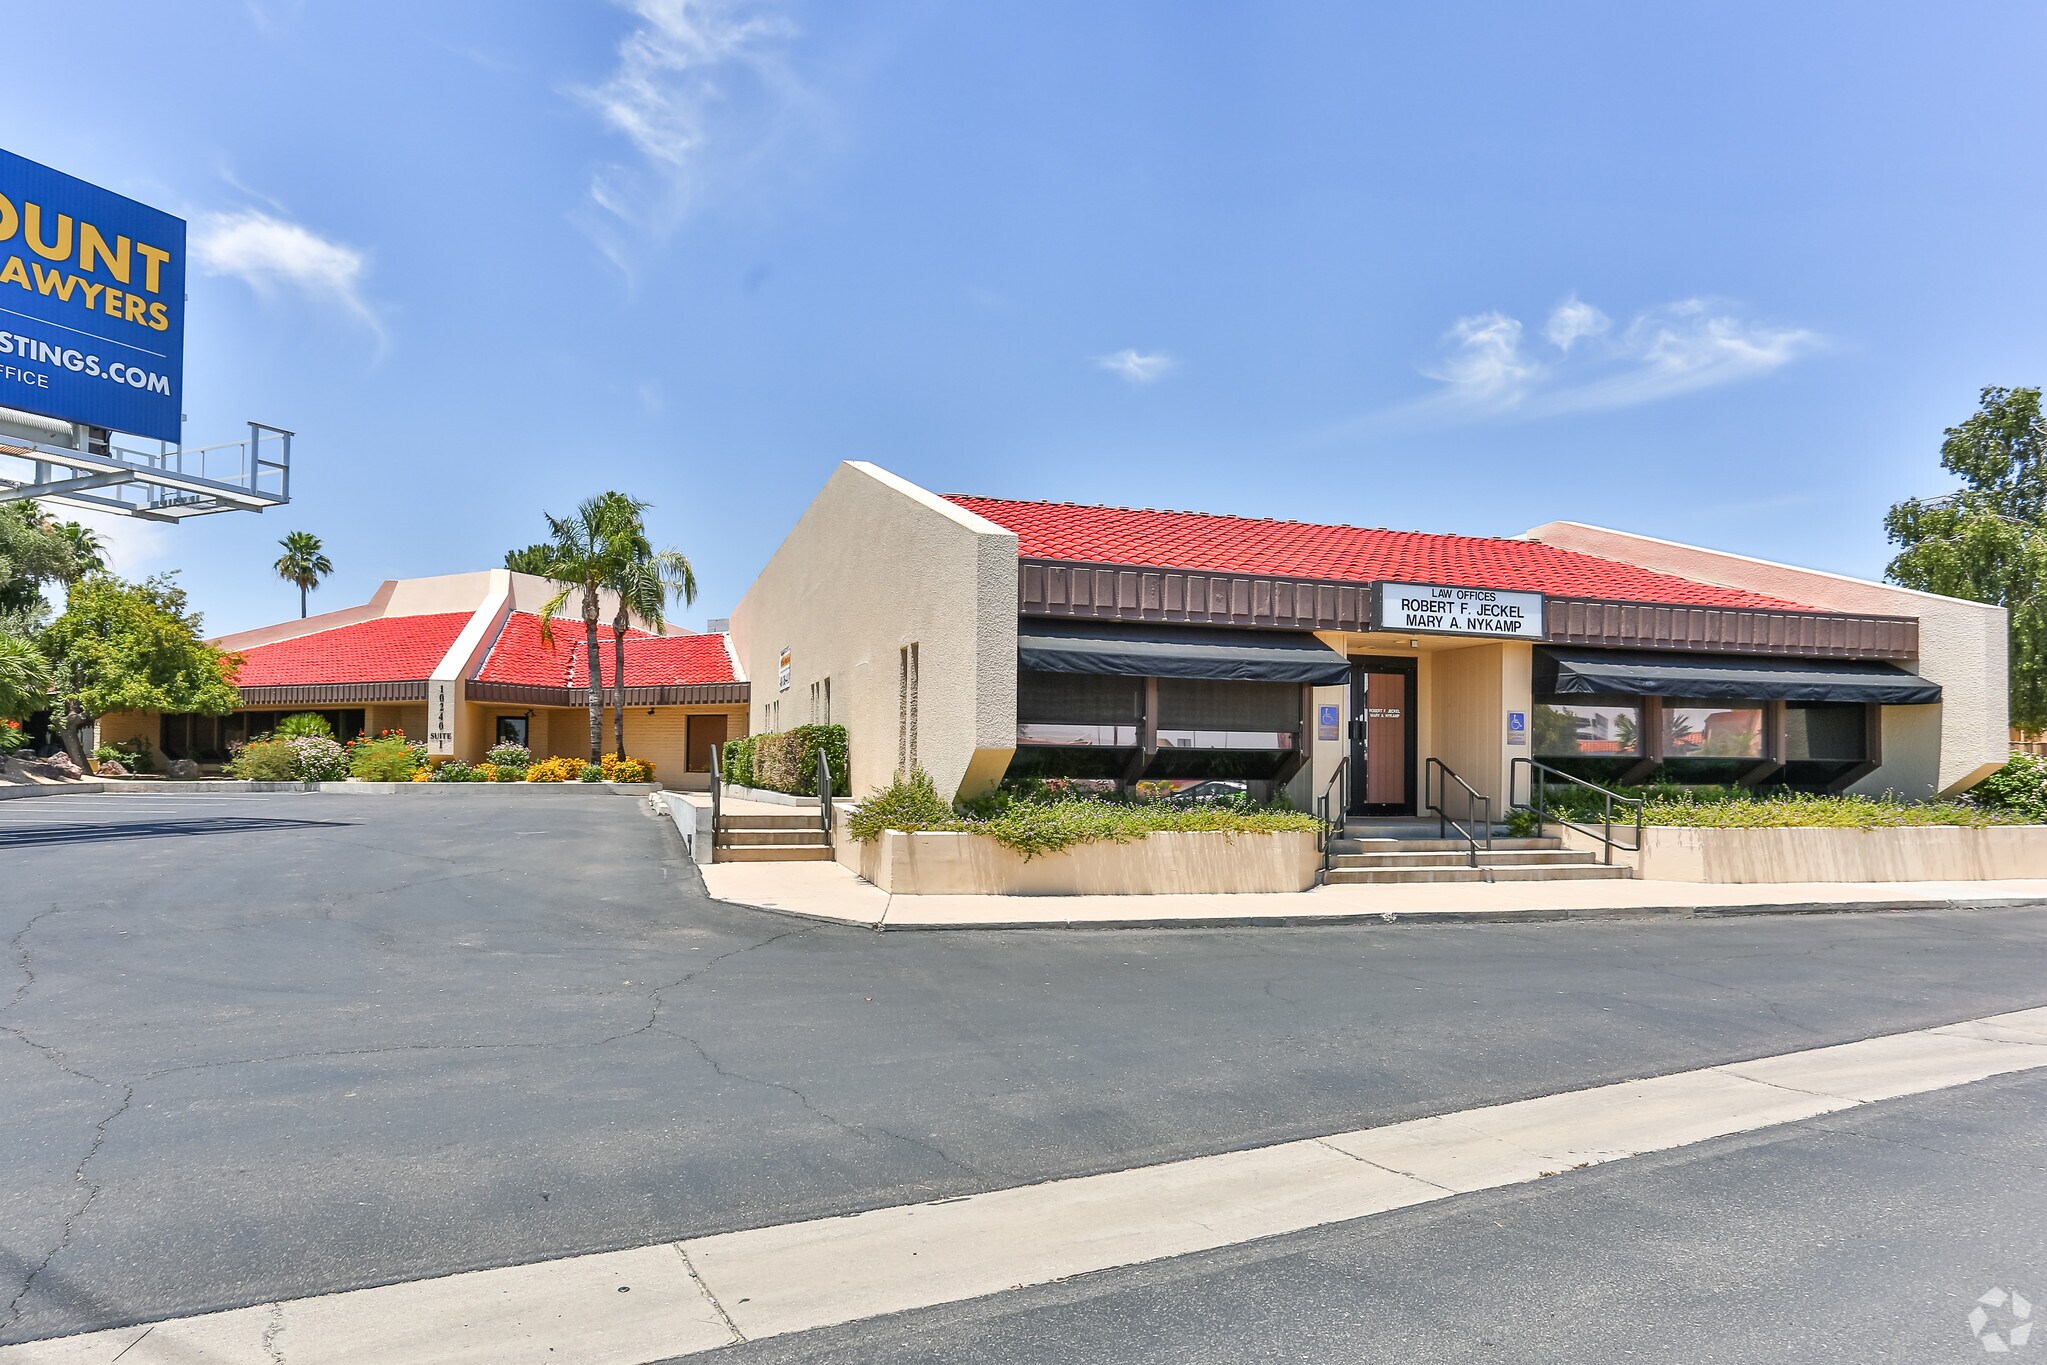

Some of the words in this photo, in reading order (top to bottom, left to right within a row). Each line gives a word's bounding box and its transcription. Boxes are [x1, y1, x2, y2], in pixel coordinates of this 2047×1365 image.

[0, 256, 169, 331] AWYERS
[0, 331, 170, 396] STINGS.COM
[1432, 589, 1452, 598] LAW
[1456, 590, 1496, 602] OFFICES
[1401, 598, 1455, 614] ROBERT
[1460, 603, 1471, 615] F.
[1477, 604, 1525, 619] JECKEL
[1406, 614, 1443, 628] MARY
[1450, 617, 1462, 629] A.
[1467, 618, 1522, 632] NYKAMP
[430, 732, 452, 740] SUITE
